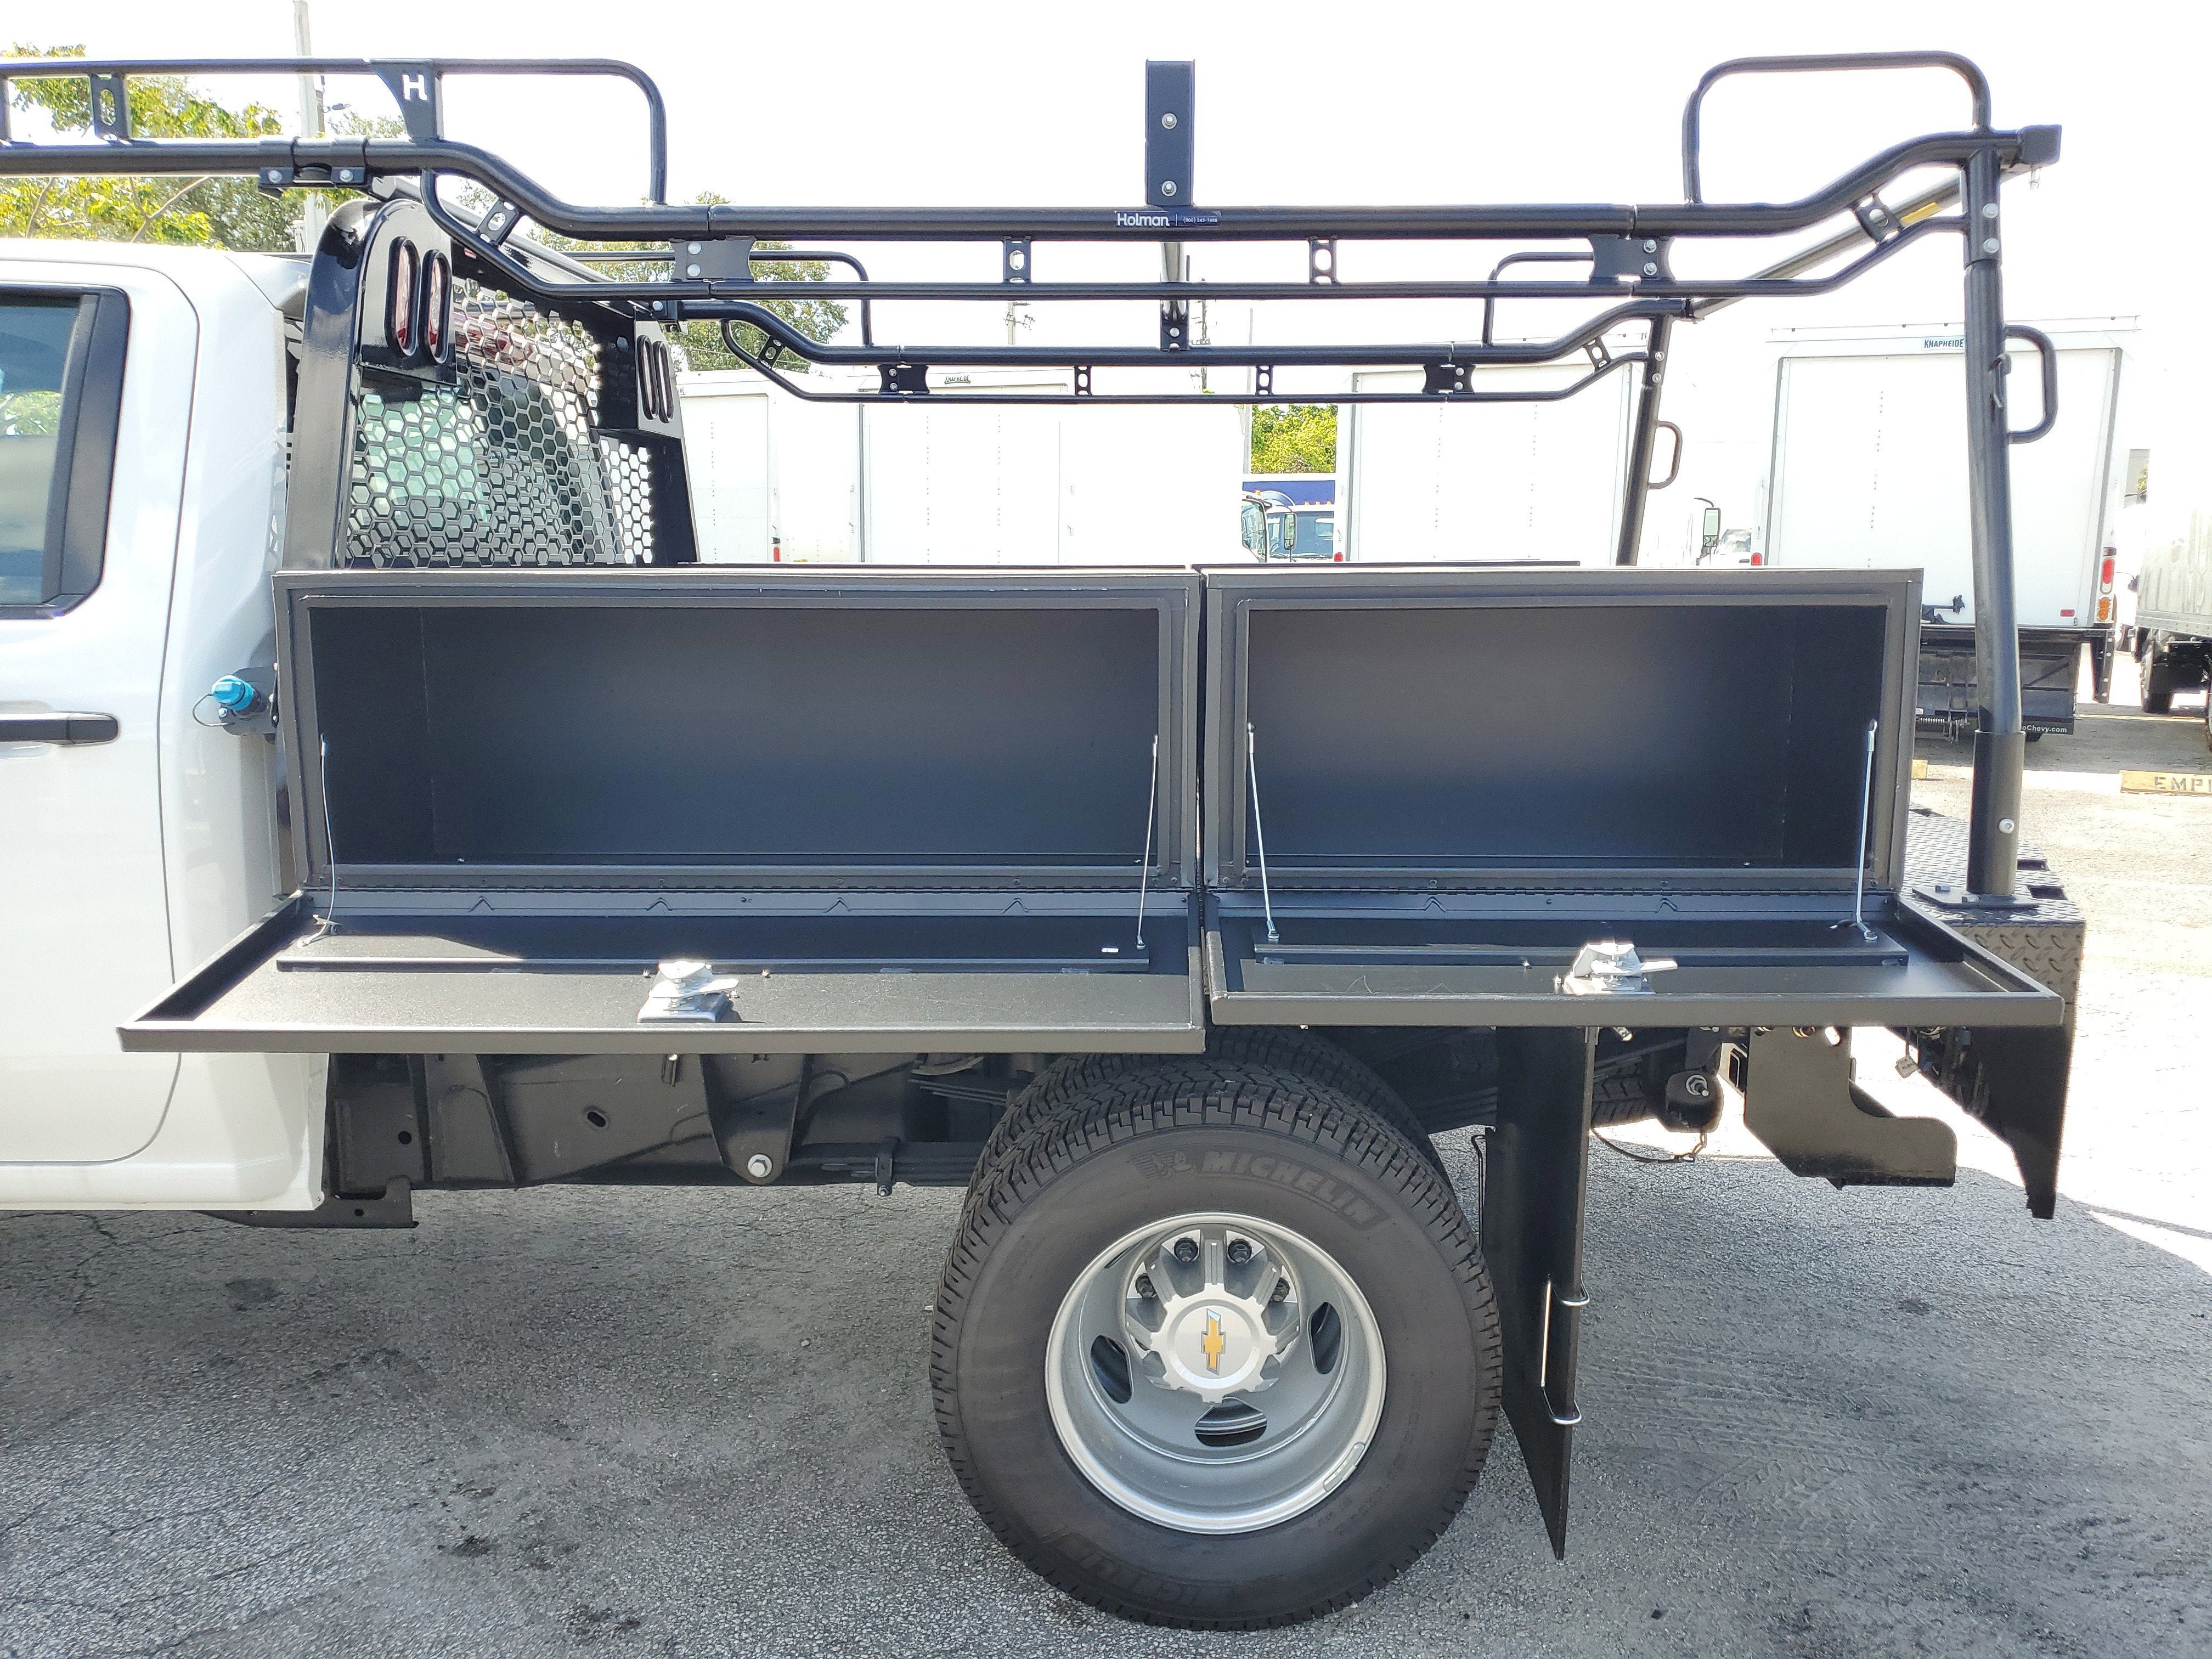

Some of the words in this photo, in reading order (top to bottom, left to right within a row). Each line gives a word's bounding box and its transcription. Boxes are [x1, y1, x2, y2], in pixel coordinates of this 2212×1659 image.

[402, 74, 428, 100] H
[1117, 213, 1170, 227] Holman
[1924, 338, 1964, 349] KNAPHEIDE
[1201, 1151, 1378, 1224] MICHELIN
